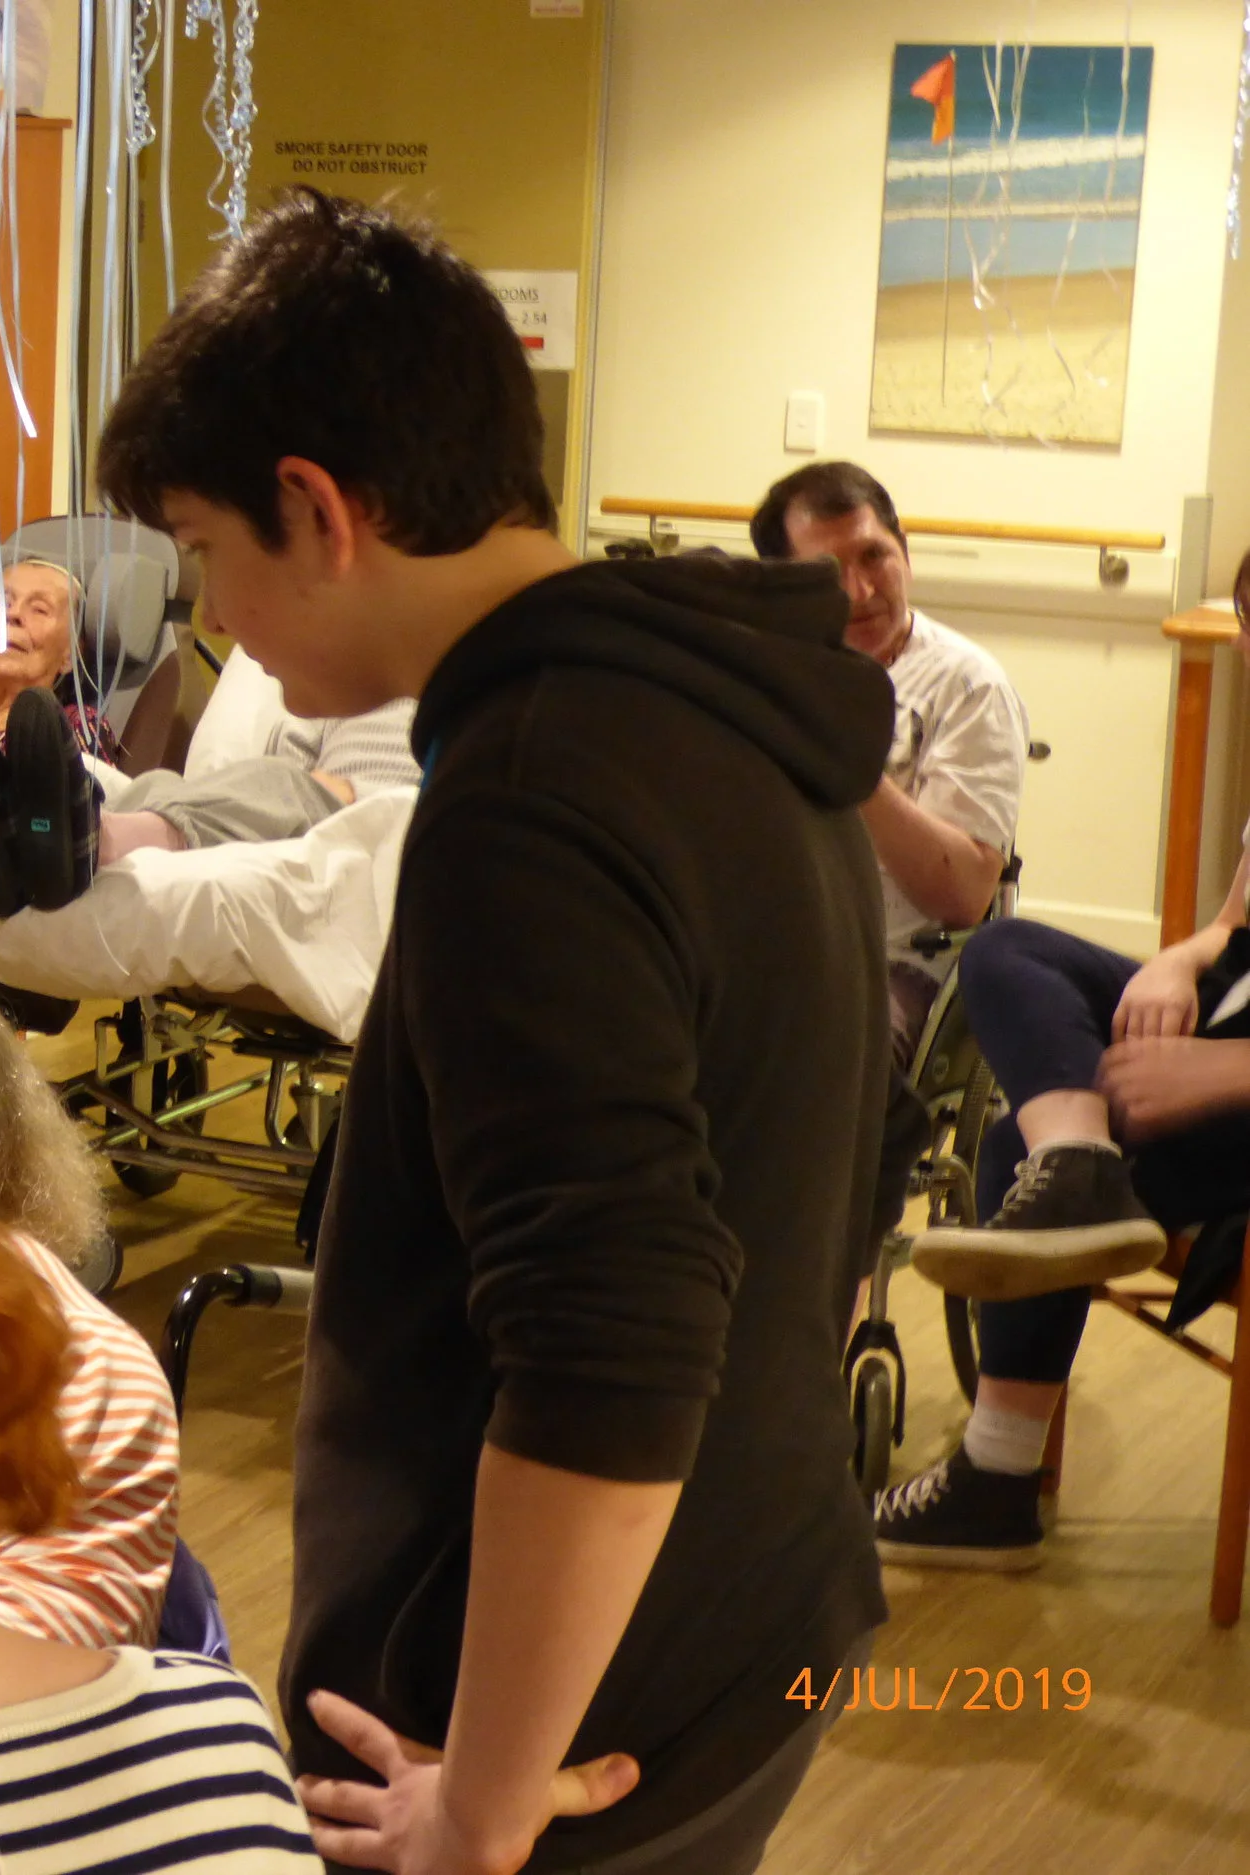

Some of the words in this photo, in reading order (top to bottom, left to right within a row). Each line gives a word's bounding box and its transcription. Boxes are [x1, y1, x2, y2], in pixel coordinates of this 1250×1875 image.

[275, 141, 322, 155] SMOKE
[328, 142, 382, 156] SAFETY
[386, 143, 428, 157] DOOR
[293, 160, 313, 173] DO
[317, 161, 345, 173] NOT
[350, 160, 426, 175] OBSTRUCT
